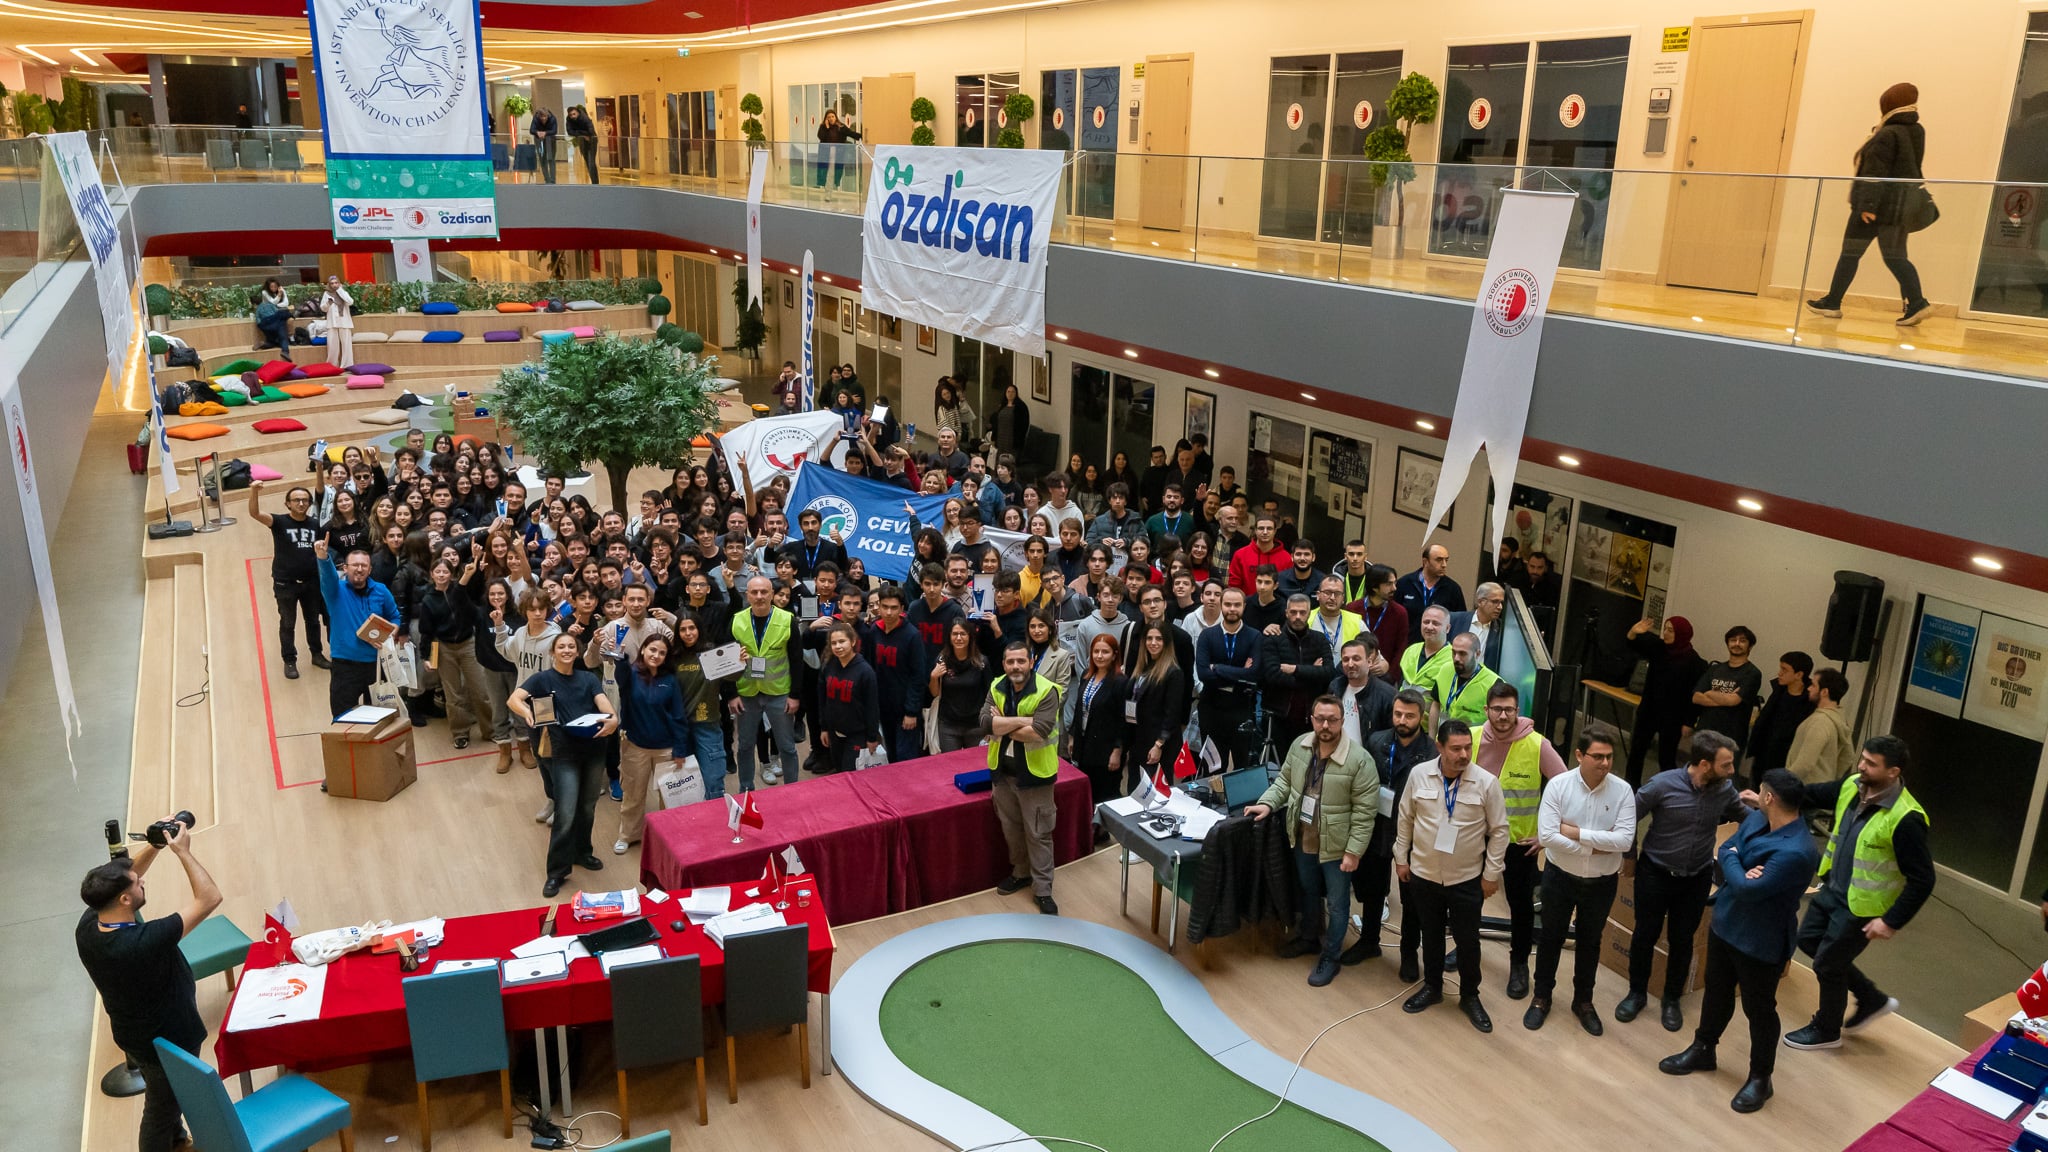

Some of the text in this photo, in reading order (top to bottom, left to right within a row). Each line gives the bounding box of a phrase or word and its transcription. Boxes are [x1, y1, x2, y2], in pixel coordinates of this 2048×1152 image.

[429, 7, 468, 60] ŞENLİĞİ
[335, 69, 467, 128] INVENTION CHALLENGE
[362, 207, 394, 218] JPL
[438, 210, 493, 225] özdisan
[880, 155, 1034, 264] özdisan
[867, 516, 911, 535] ÇEV
[1996, 641, 2042, 662] BIG BROTHER
[1990, 676, 2033, 697] IS WATCHING
[2000, 689, 2019, 709] YOU
